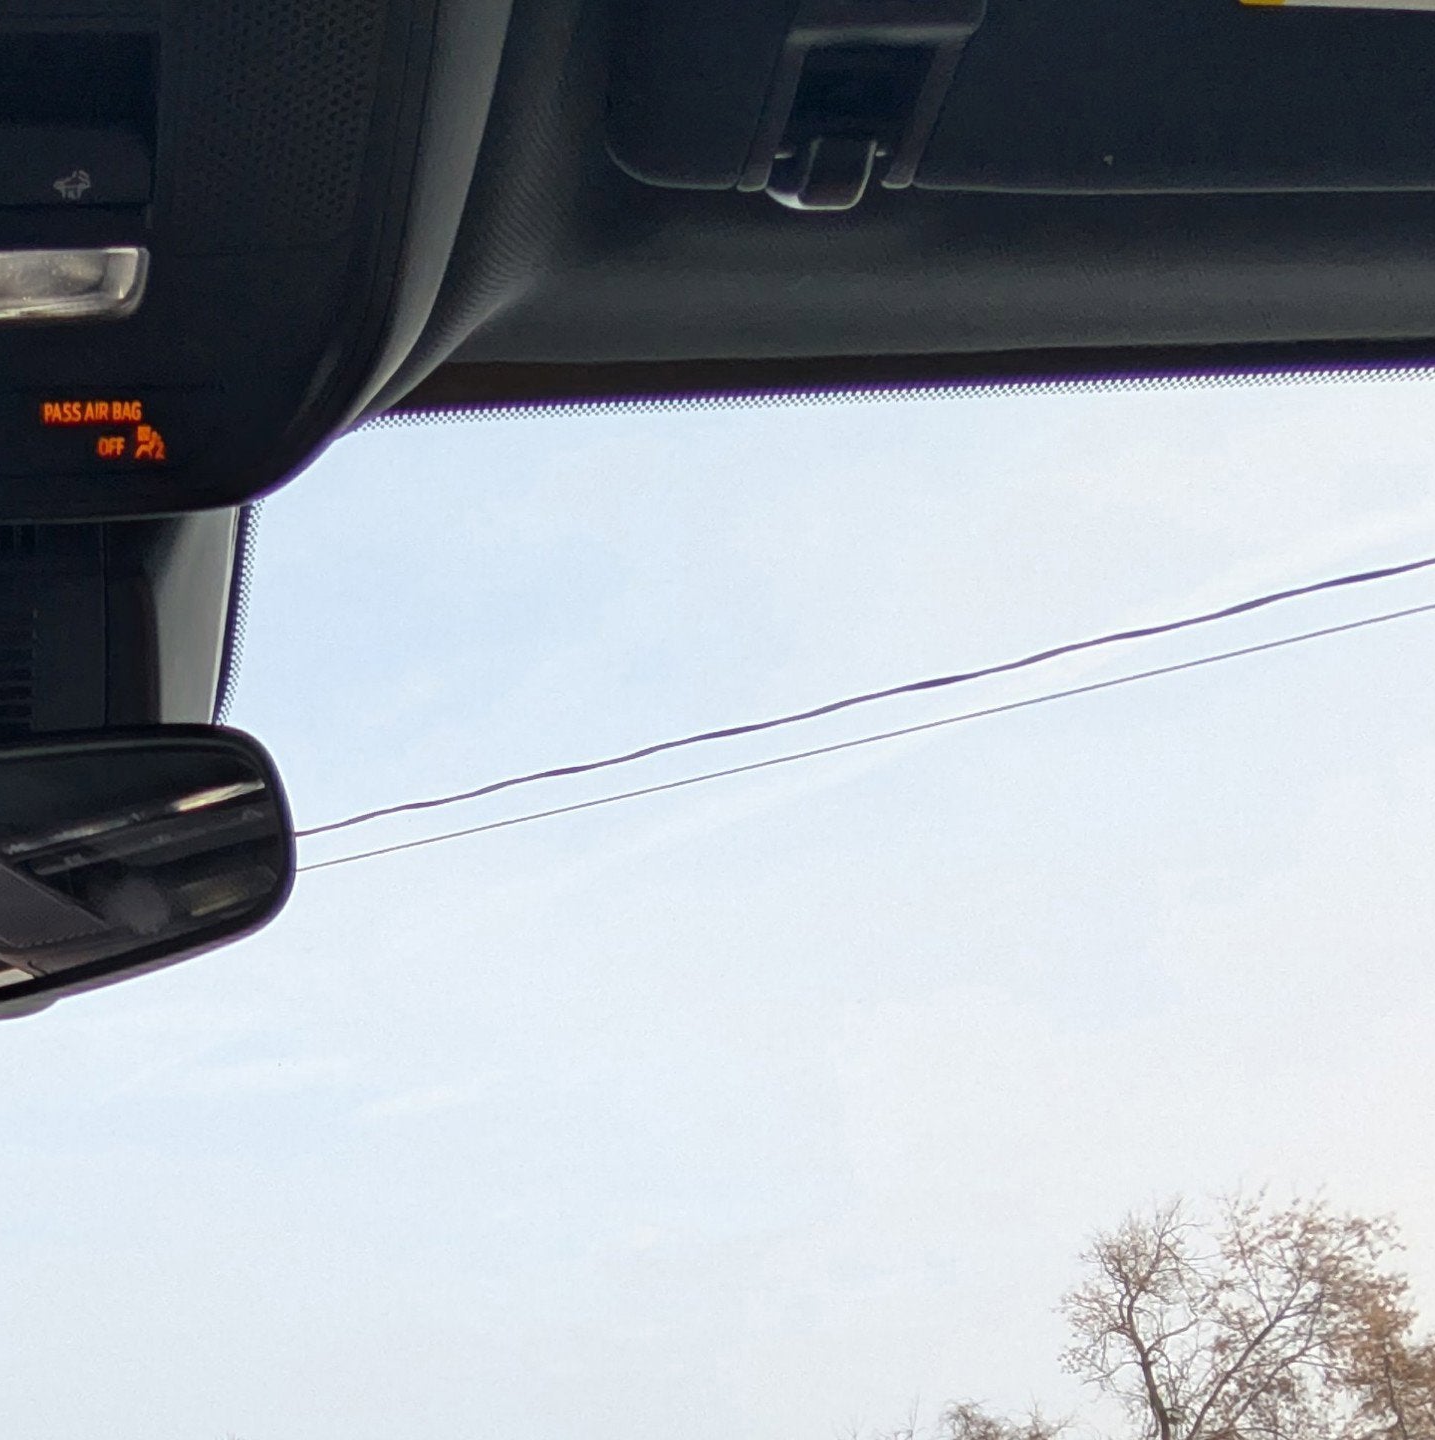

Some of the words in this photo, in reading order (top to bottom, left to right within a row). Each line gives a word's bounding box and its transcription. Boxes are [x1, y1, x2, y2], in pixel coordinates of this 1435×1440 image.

[43, 402, 82, 422] PASS
[84, 401, 109, 421] AIR
[111, 400, 142, 420] BAG
[97, 437, 124, 456] OFF
